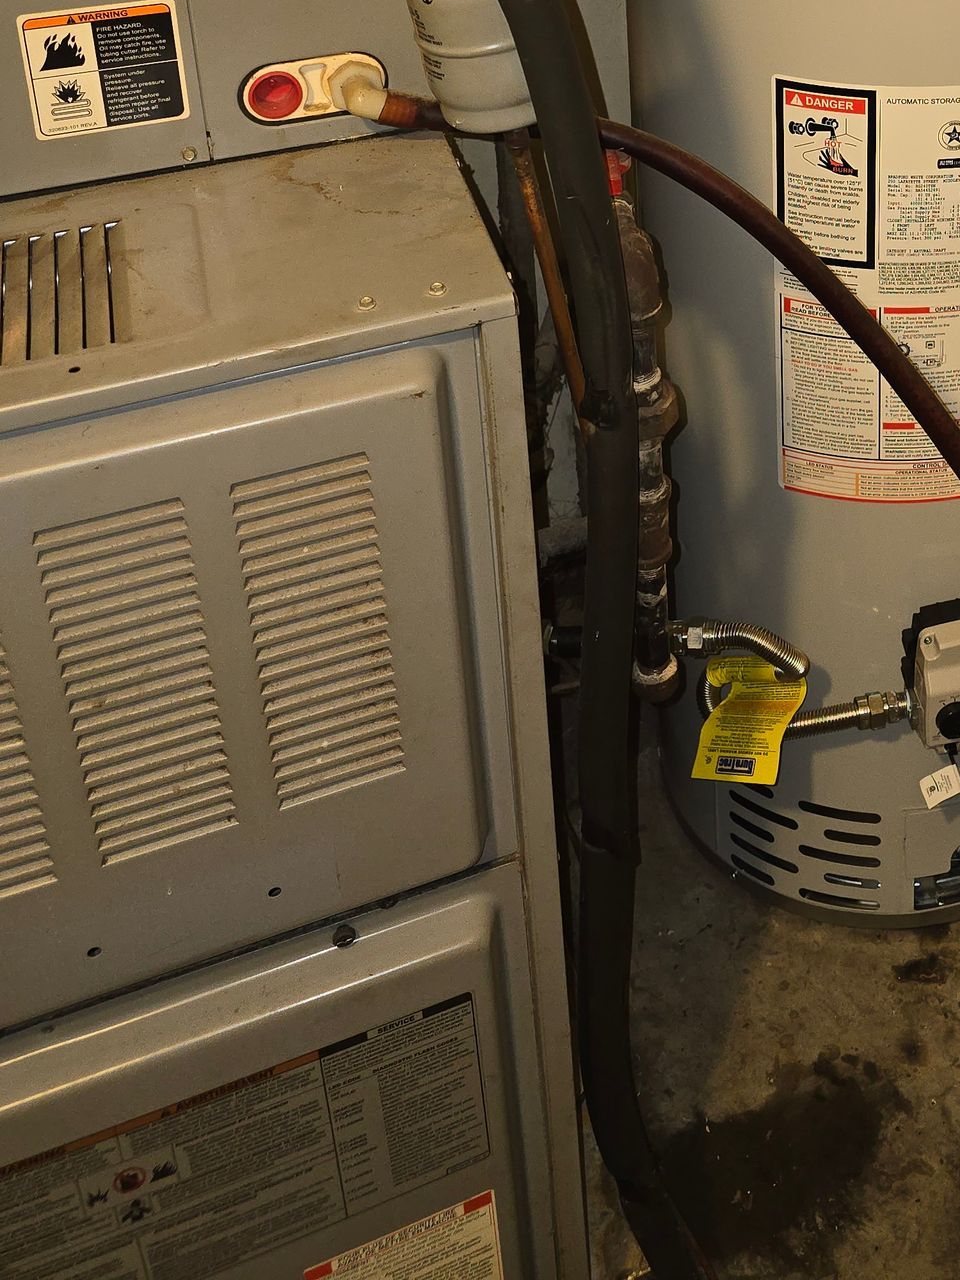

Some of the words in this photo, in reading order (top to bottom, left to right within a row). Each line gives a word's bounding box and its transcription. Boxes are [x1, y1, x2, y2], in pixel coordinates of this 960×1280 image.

[78, 10, 128, 22] WARNING
[100, 51, 120, 59] tubing
[103, 72, 126, 80] System
[138, 79, 165, 88] pressure
[107, 95, 139, 104] refrigerant
[131, 100, 149, 108] repair
[805, 96, 854, 110] DANGER
[824, 140, 842, 148] HOT
[802, 174, 832, 184] temperature
[798, 211, 823, 219] instruction
[804, 217, 834, 226] temperature
[807, 310, 830, 318] BEFORE
[377, 1015, 416, 1034] SERVICE
